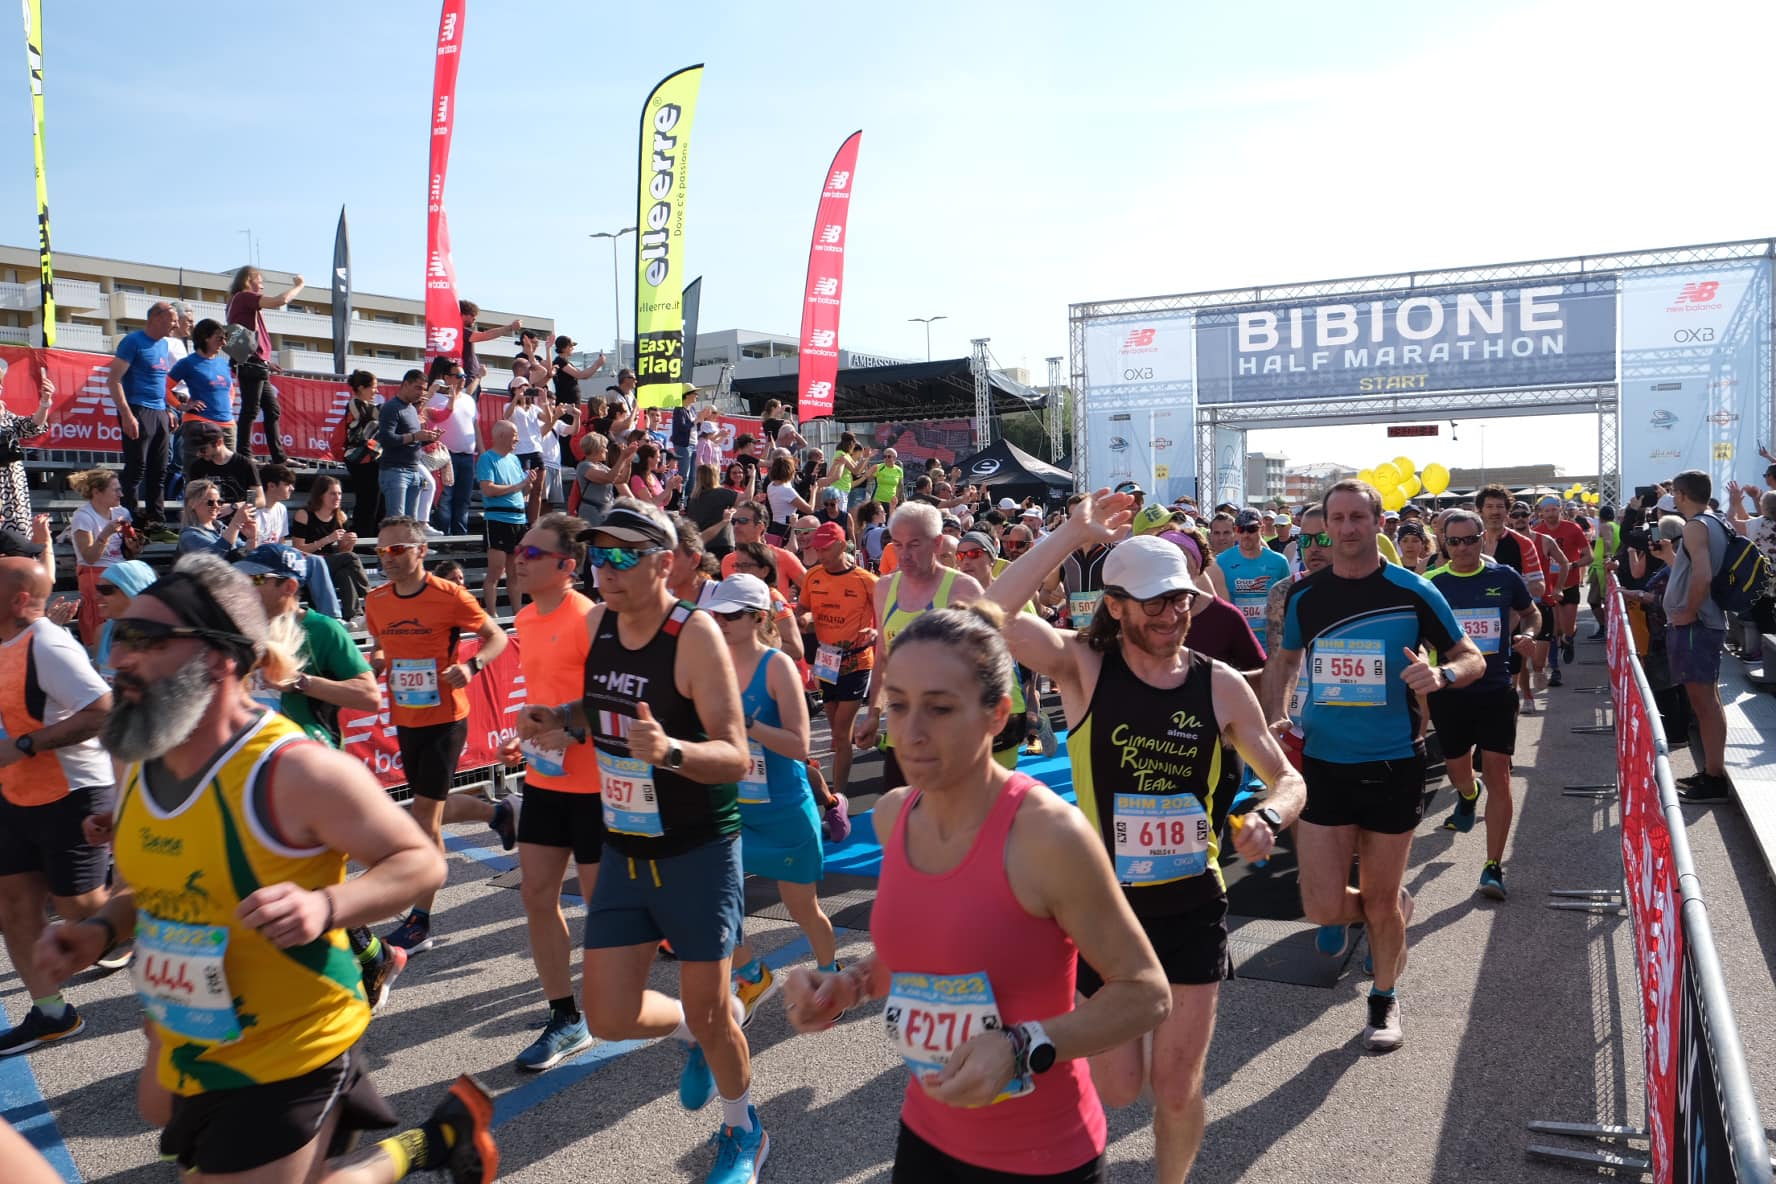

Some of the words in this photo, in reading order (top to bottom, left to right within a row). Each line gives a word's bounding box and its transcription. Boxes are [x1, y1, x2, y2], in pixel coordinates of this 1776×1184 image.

[641, 103, 682, 287] elleerre
[674, 210, 683, 236] Dove
[679, 142, 688, 189] passione
[1238, 286, 1563, 352] BIBIONE
[1685, 304, 1722, 312] balance
[639, 338, 681, 356] Easy-
[1239, 351, 1306, 375] HALF
[1344, 335, 1563, 369] MARATHON
[638, 356, 681, 378] Flag
[1359, 374, 1428, 391] START
[51, 424, 92, 440] new
[1243, 607, 1260, 617] 504
[1464, 621, 1488, 634] 535
[1331, 658, 1365, 677] 556
[400, 673, 423, 687] 520
[607, 670, 649, 698] MET
[1111, 724, 1198, 758] CIMAVILLA
[1120, 746, 1192, 777] RUNNING
[607, 778, 633, 803] 657
[1118, 797, 1156, 809] BHM
[1139, 821, 1185, 847] 618
[145, 954, 195, 994] 444
